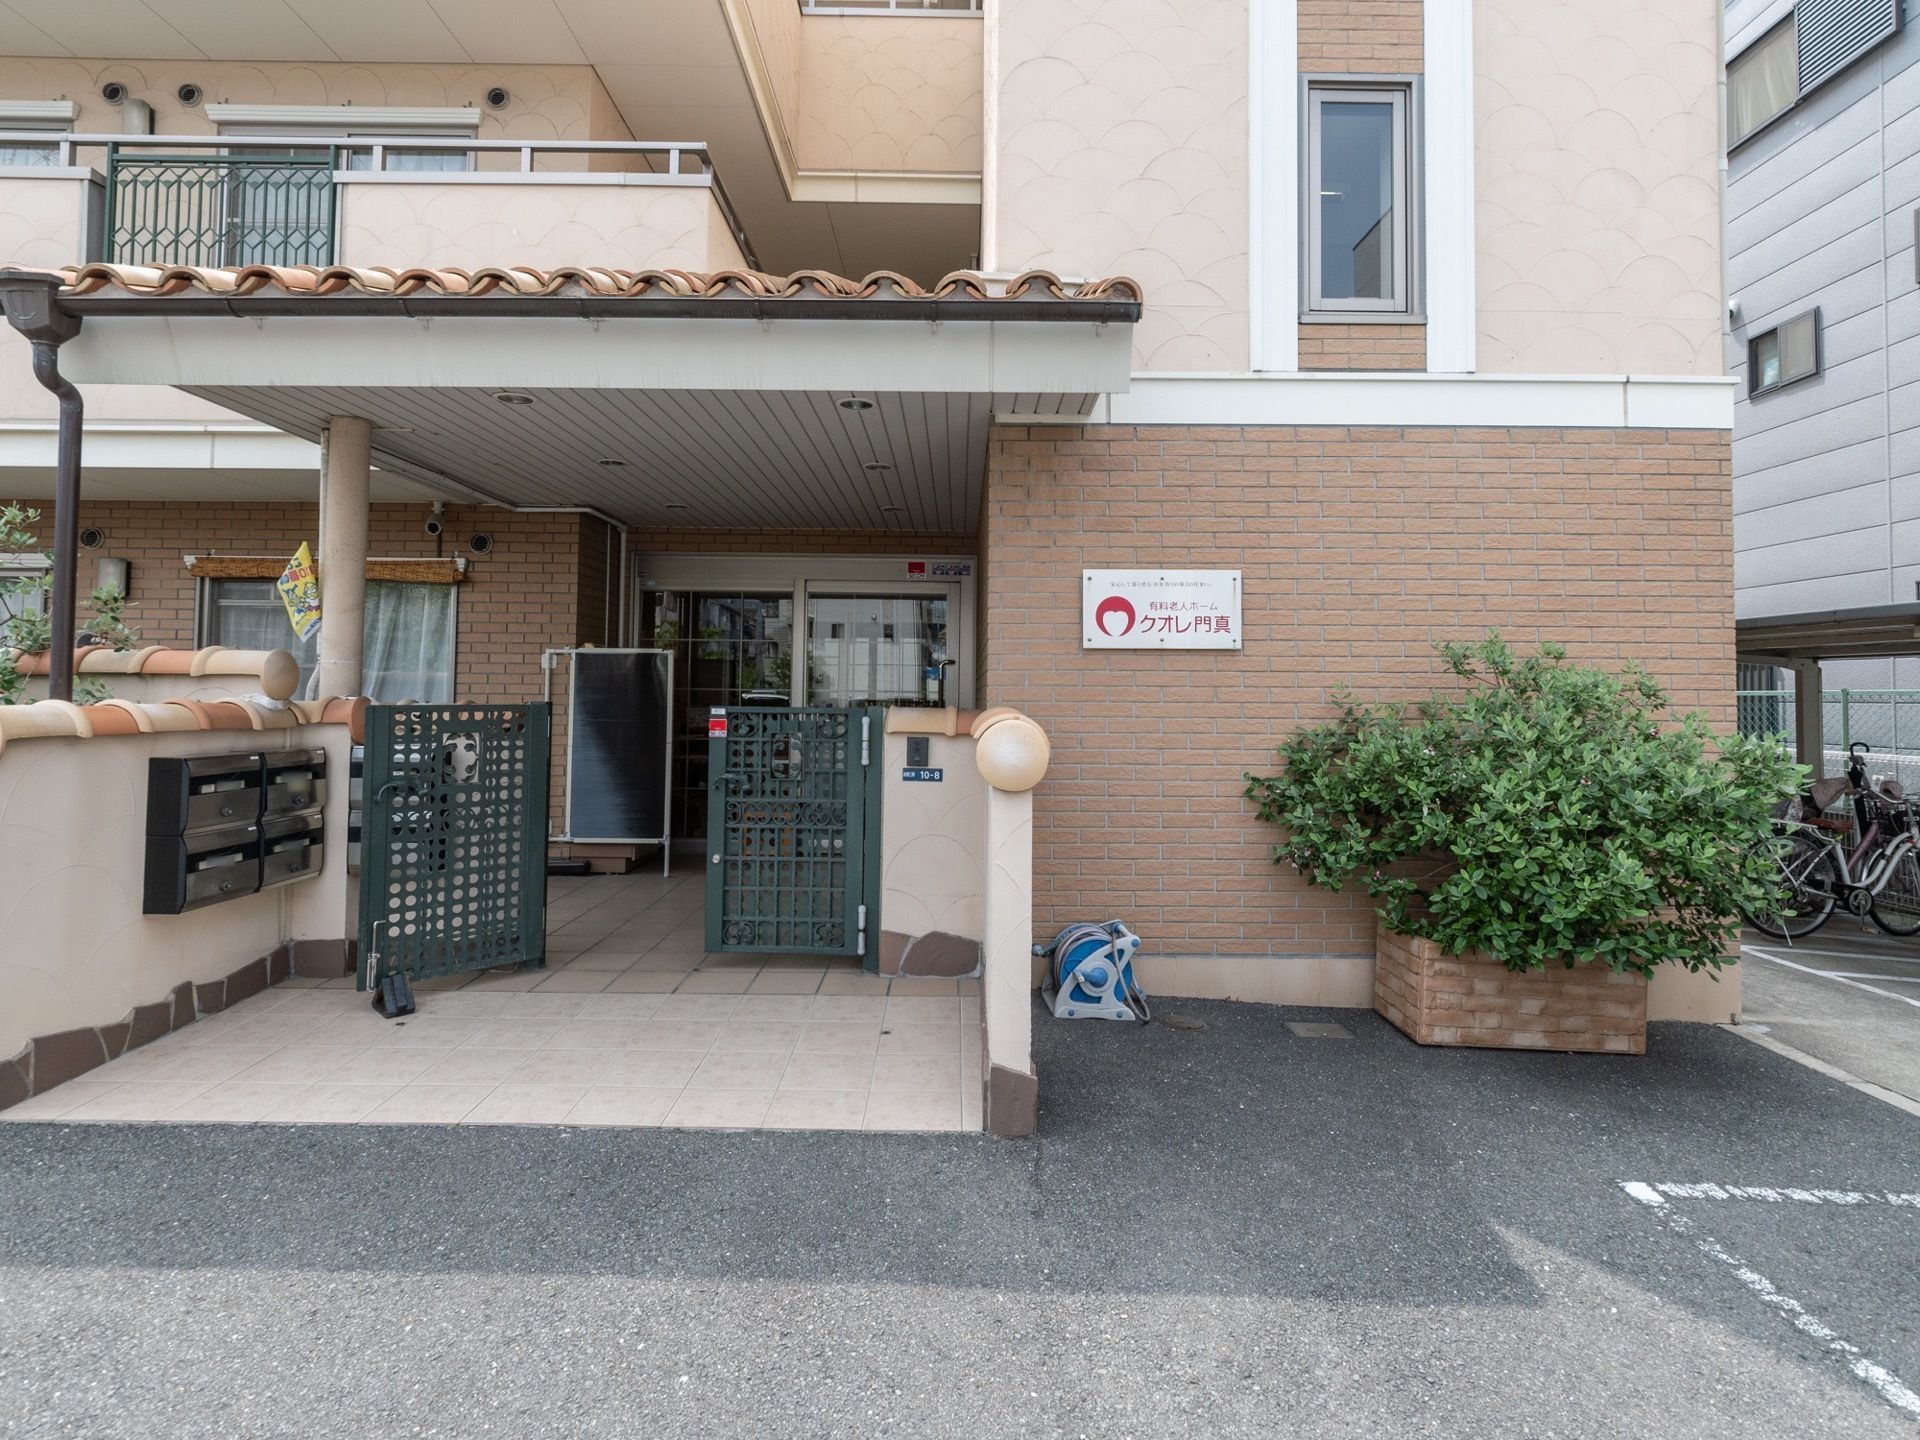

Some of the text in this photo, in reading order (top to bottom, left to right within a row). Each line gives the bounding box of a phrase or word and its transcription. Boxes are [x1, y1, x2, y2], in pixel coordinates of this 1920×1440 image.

[1149, 601, 1218, 612] 有料老人ホーム
[1140, 614, 1231, 634] クオレ門真
[920, 771, 940, 780] 10-8
